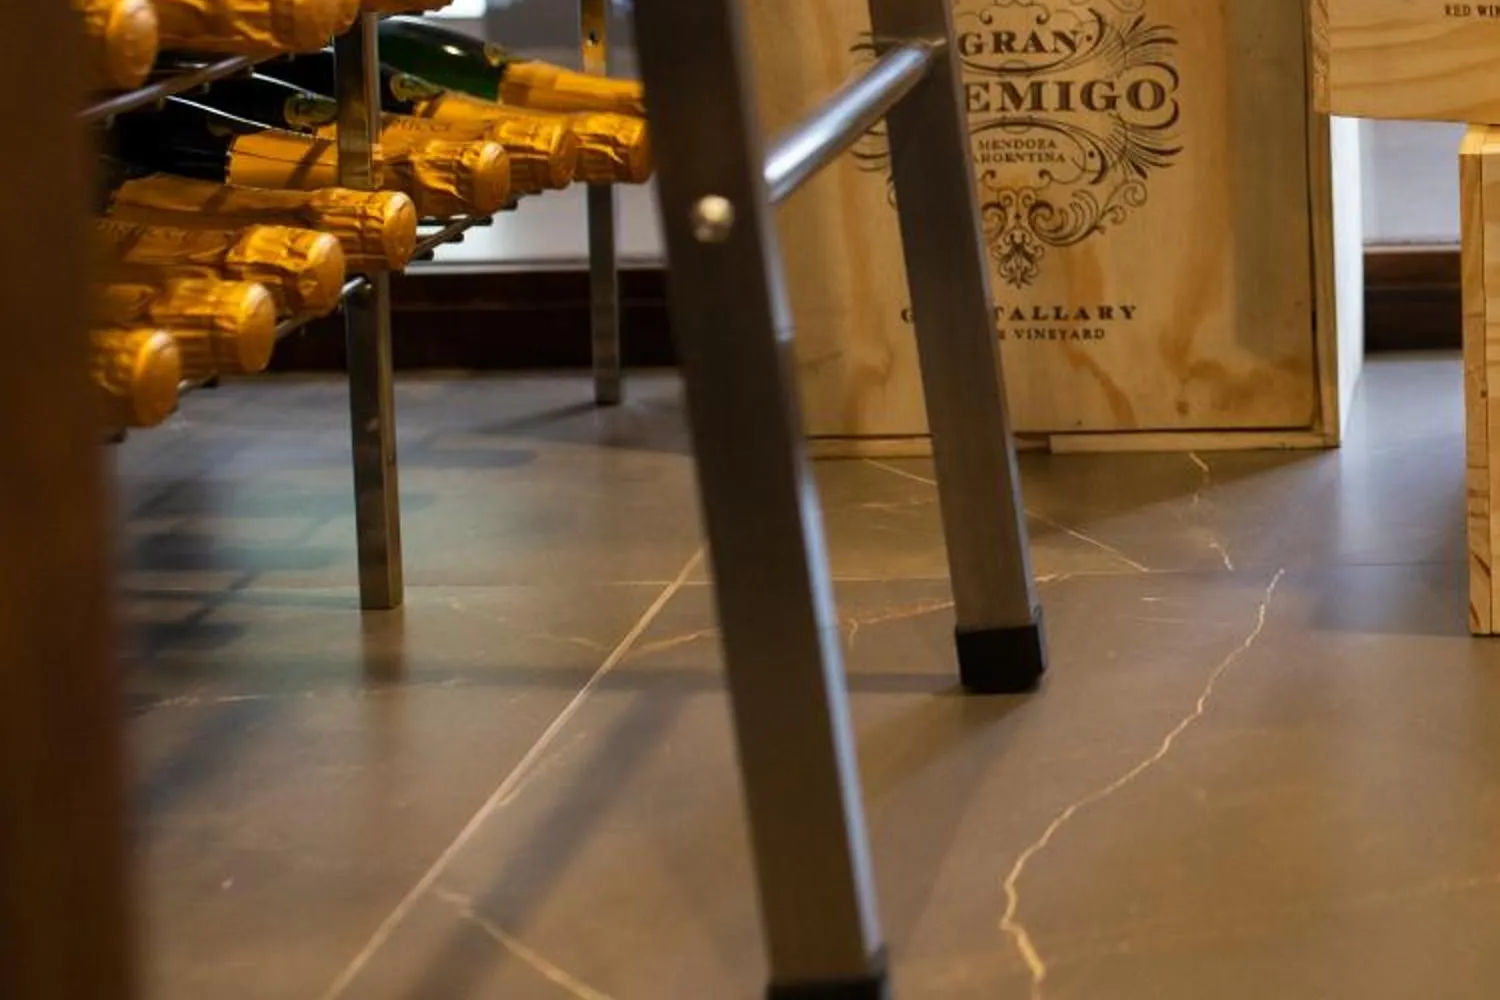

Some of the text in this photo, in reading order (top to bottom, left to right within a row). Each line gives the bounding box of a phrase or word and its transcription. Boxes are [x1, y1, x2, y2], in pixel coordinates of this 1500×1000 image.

[1444, 4, 1471, 18] RED
[957, 29, 1079, 57] GRAN
[964, 78, 1166, 113] EMIGO
[979, 139, 1057, 151] MENDOZA
[900, 305, 1137, 323] GTALLARY
[1013, 328, 1105, 341] VINEYARD
